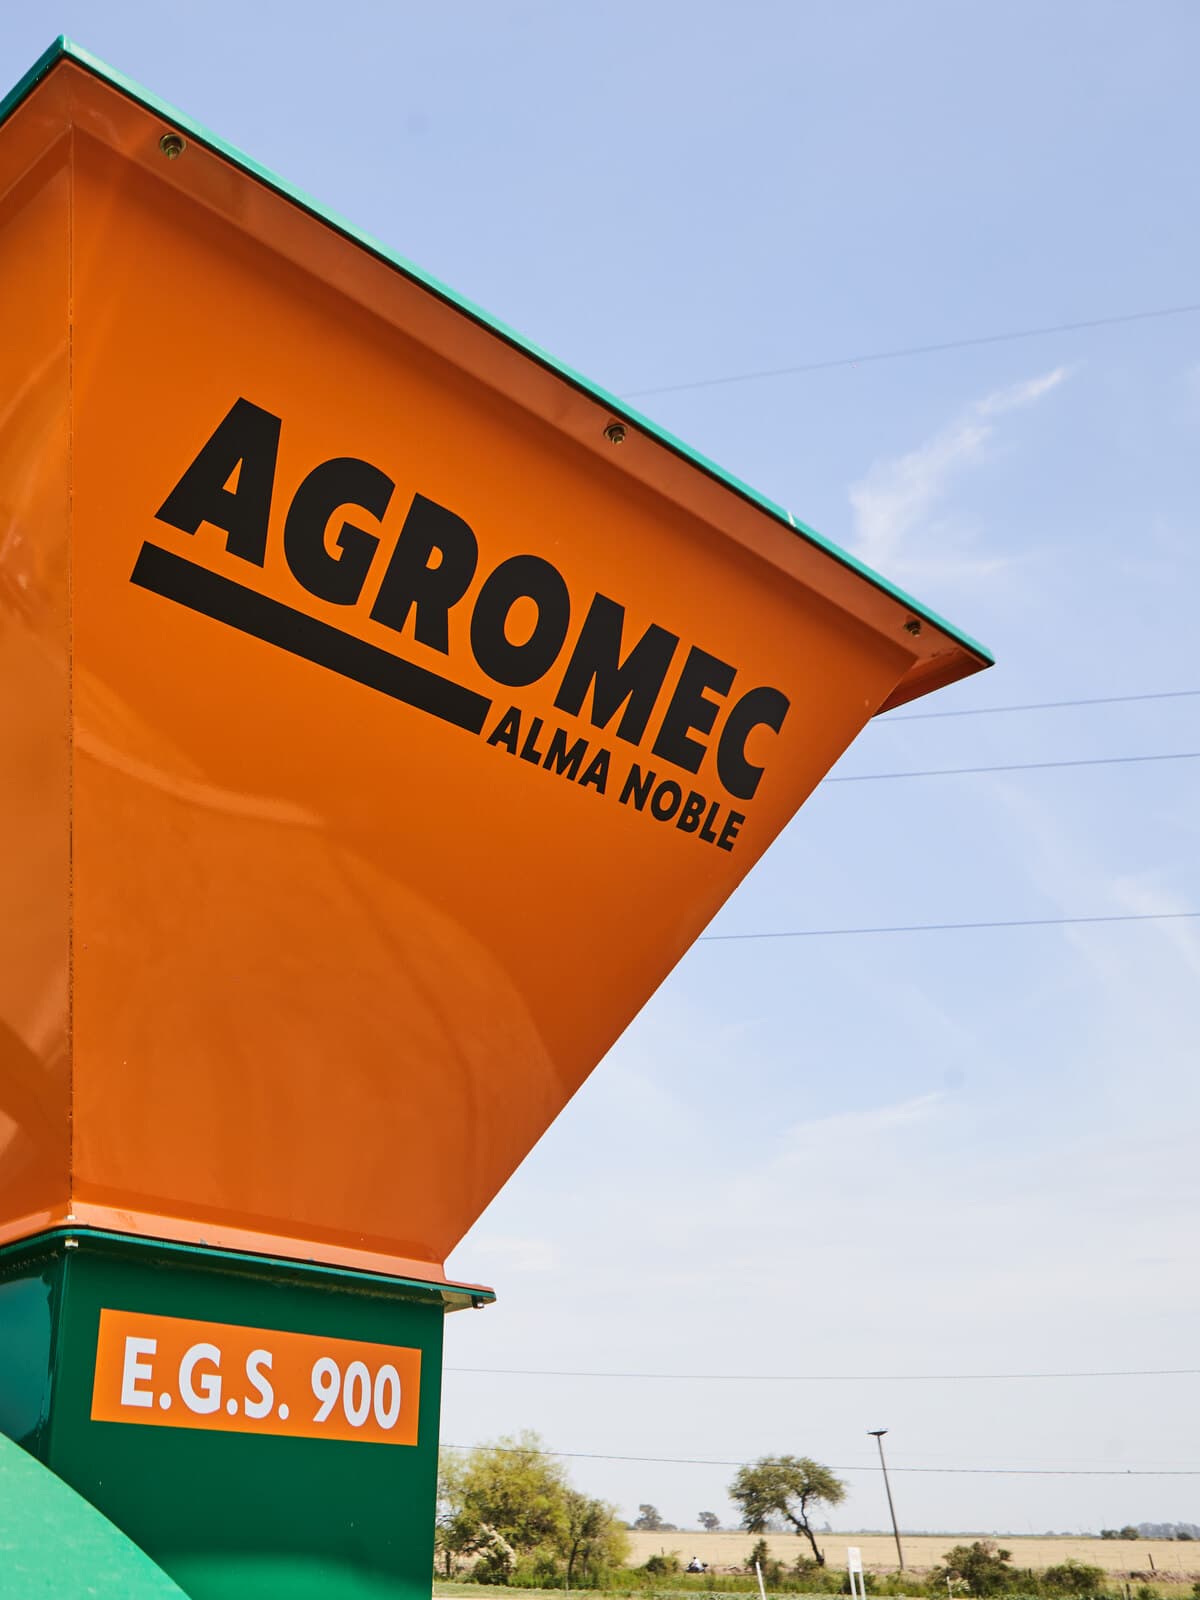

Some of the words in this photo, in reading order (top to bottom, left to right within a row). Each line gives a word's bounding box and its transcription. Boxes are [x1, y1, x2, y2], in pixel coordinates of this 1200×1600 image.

[154, 397, 791, 800] AGROMEC
[486, 706, 611, 795] ALMA
[618, 763, 746, 852] NOBLE
[120, 1336, 290, 1420] E.G.S.
[311, 1356, 402, 1430] 900
